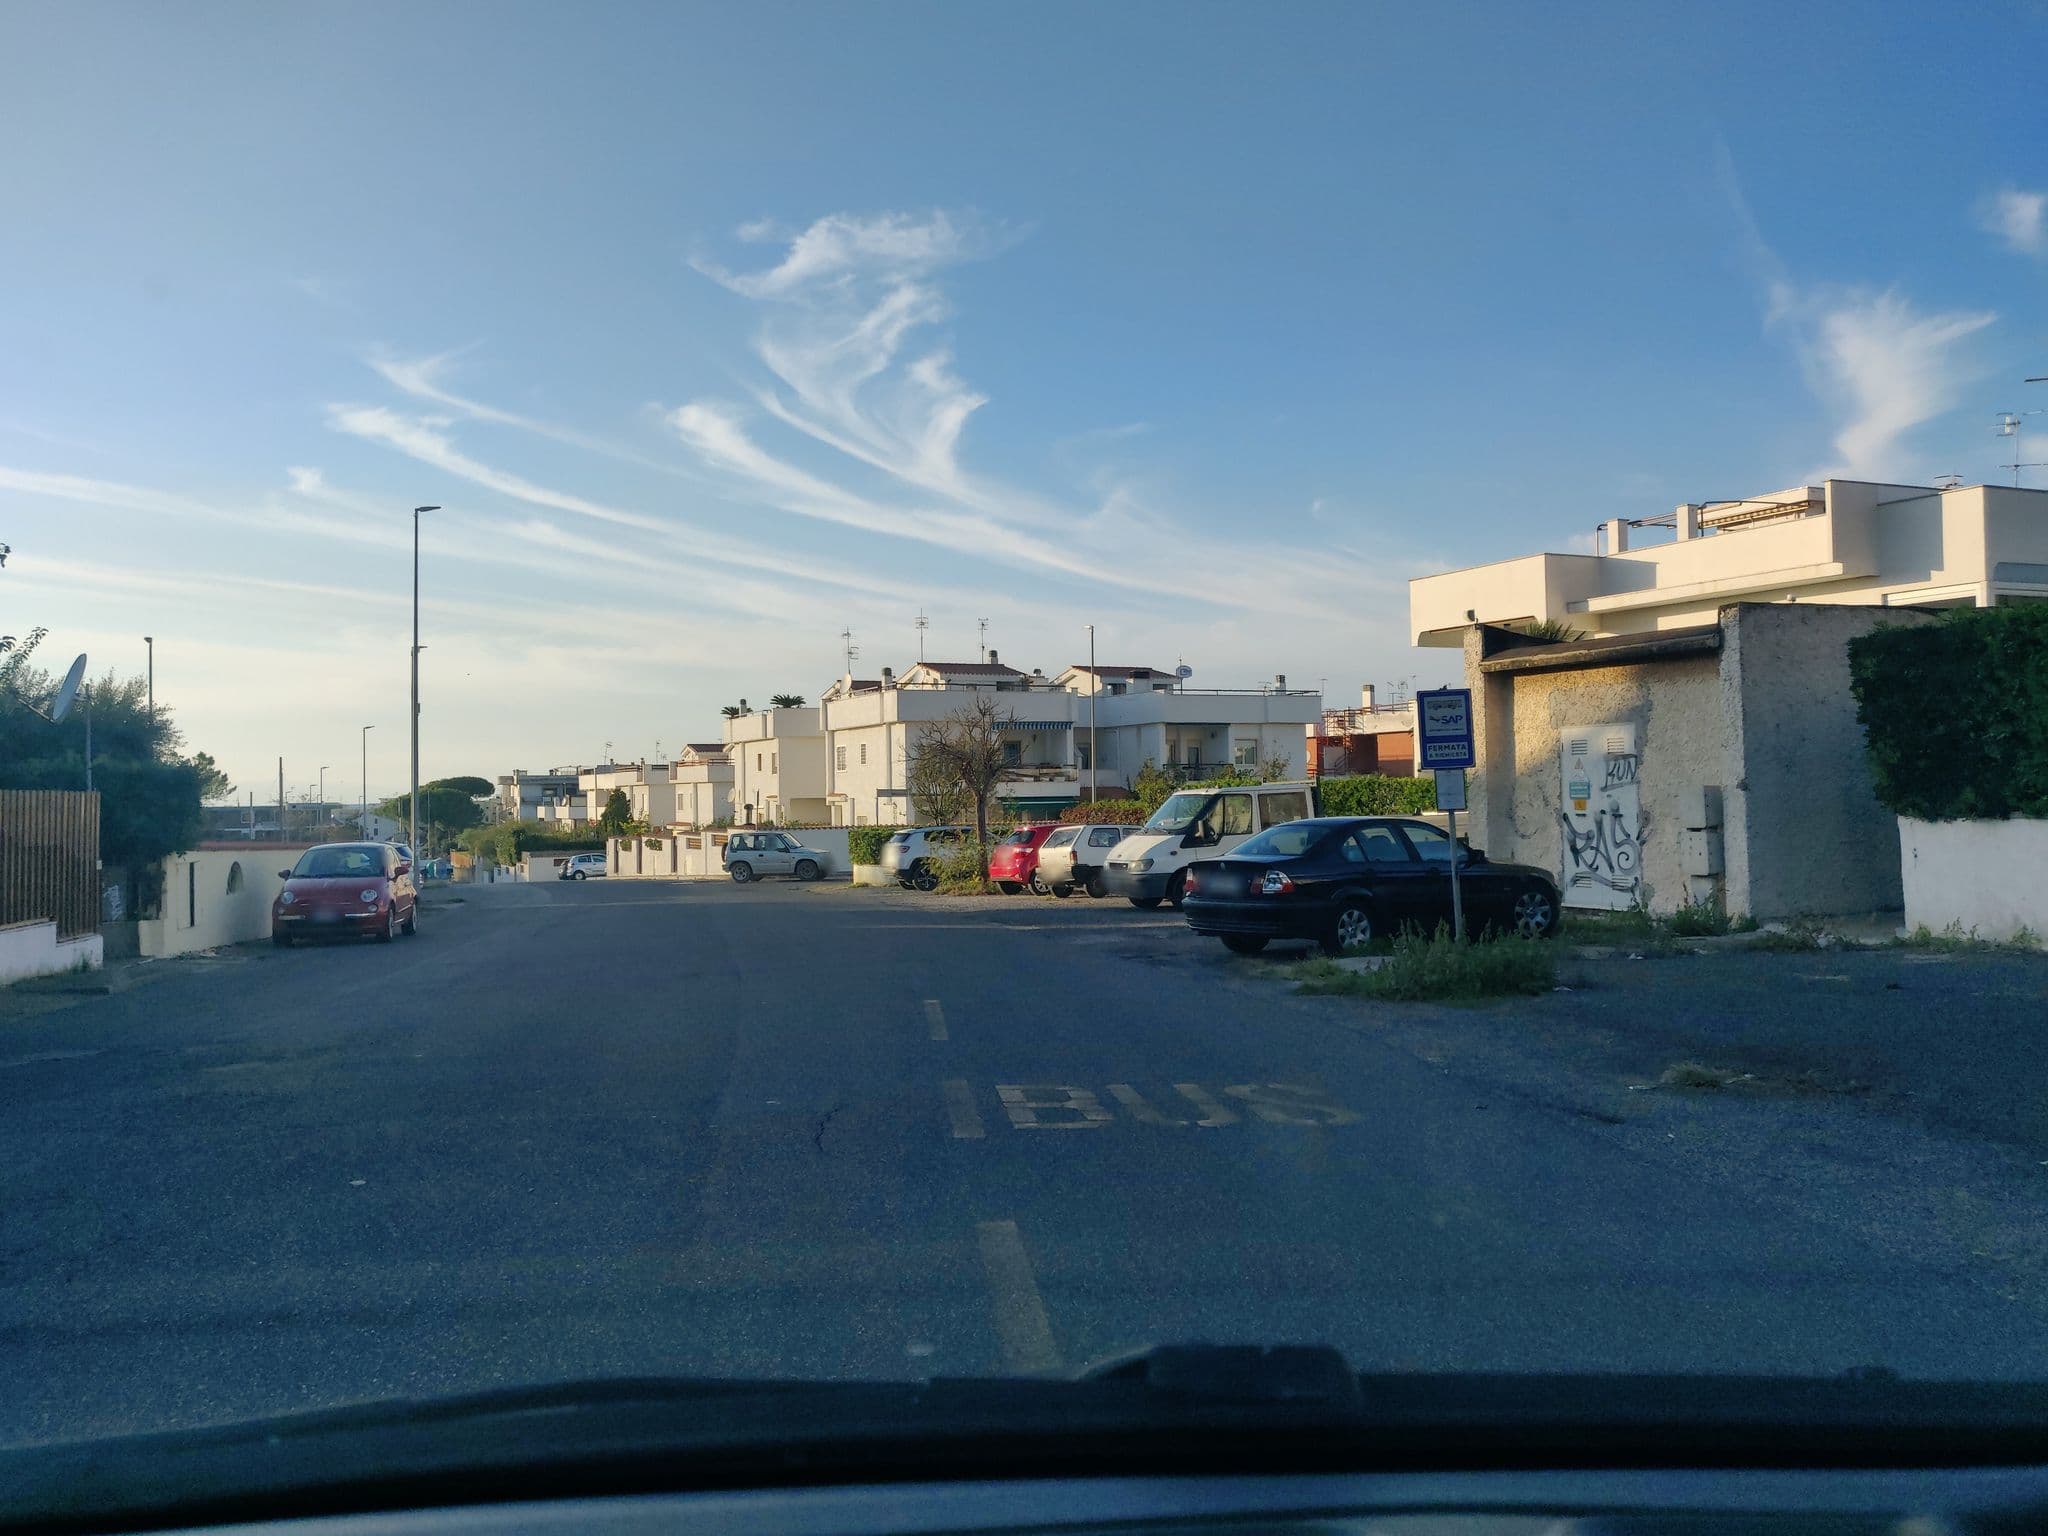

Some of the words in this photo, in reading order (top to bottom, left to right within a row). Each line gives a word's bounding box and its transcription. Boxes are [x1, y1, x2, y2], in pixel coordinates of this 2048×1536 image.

[1441, 714, 1464, 725] SAP
[1427, 743, 1467, 752] FERMATA
[995, 1083, 1362, 1129] BUS
